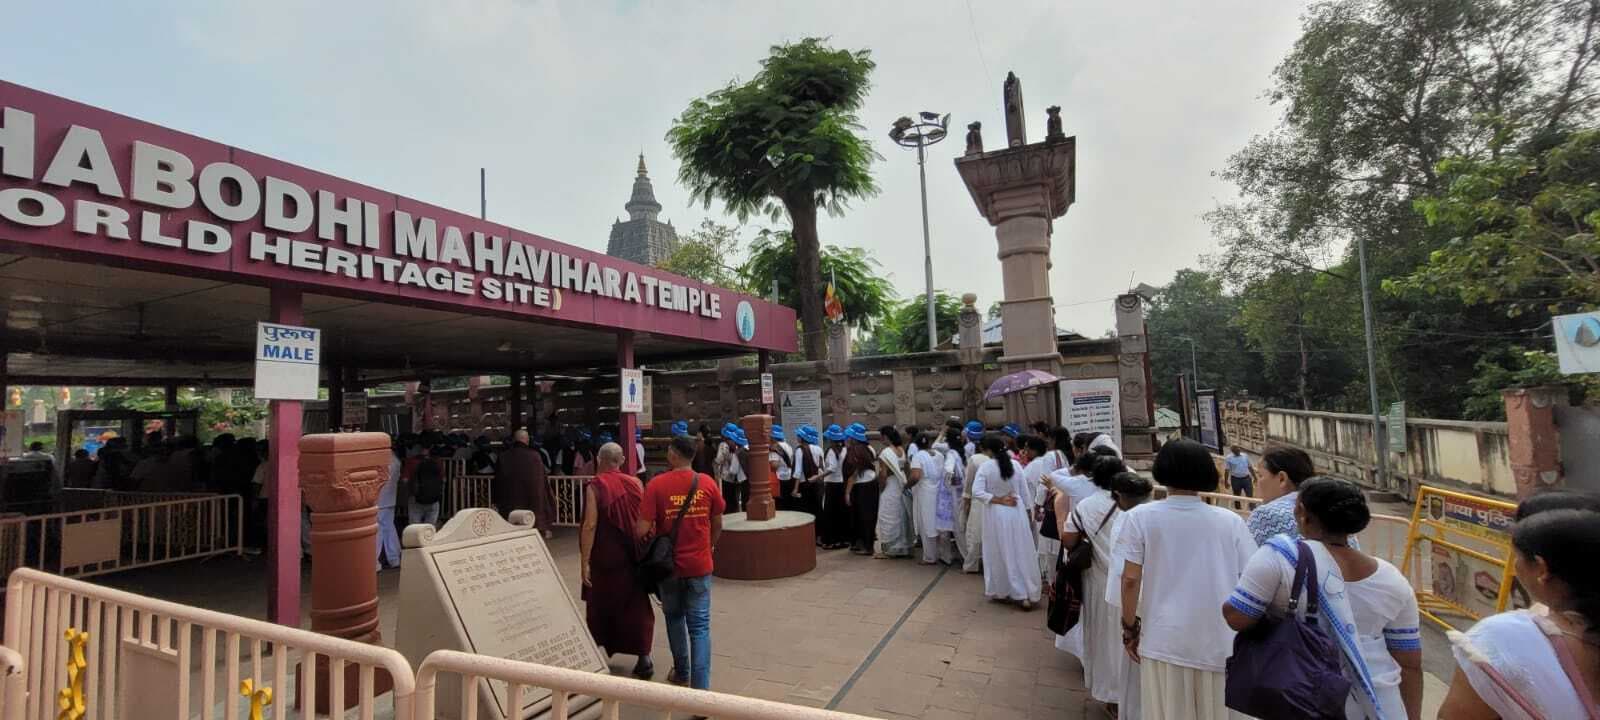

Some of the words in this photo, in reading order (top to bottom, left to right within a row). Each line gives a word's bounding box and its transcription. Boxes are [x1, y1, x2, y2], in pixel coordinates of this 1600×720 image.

[250, 231, 476, 296] HERITAGE
[263, 344, 314, 361] MALE
[1476, 508, 1514, 528] पुलि
